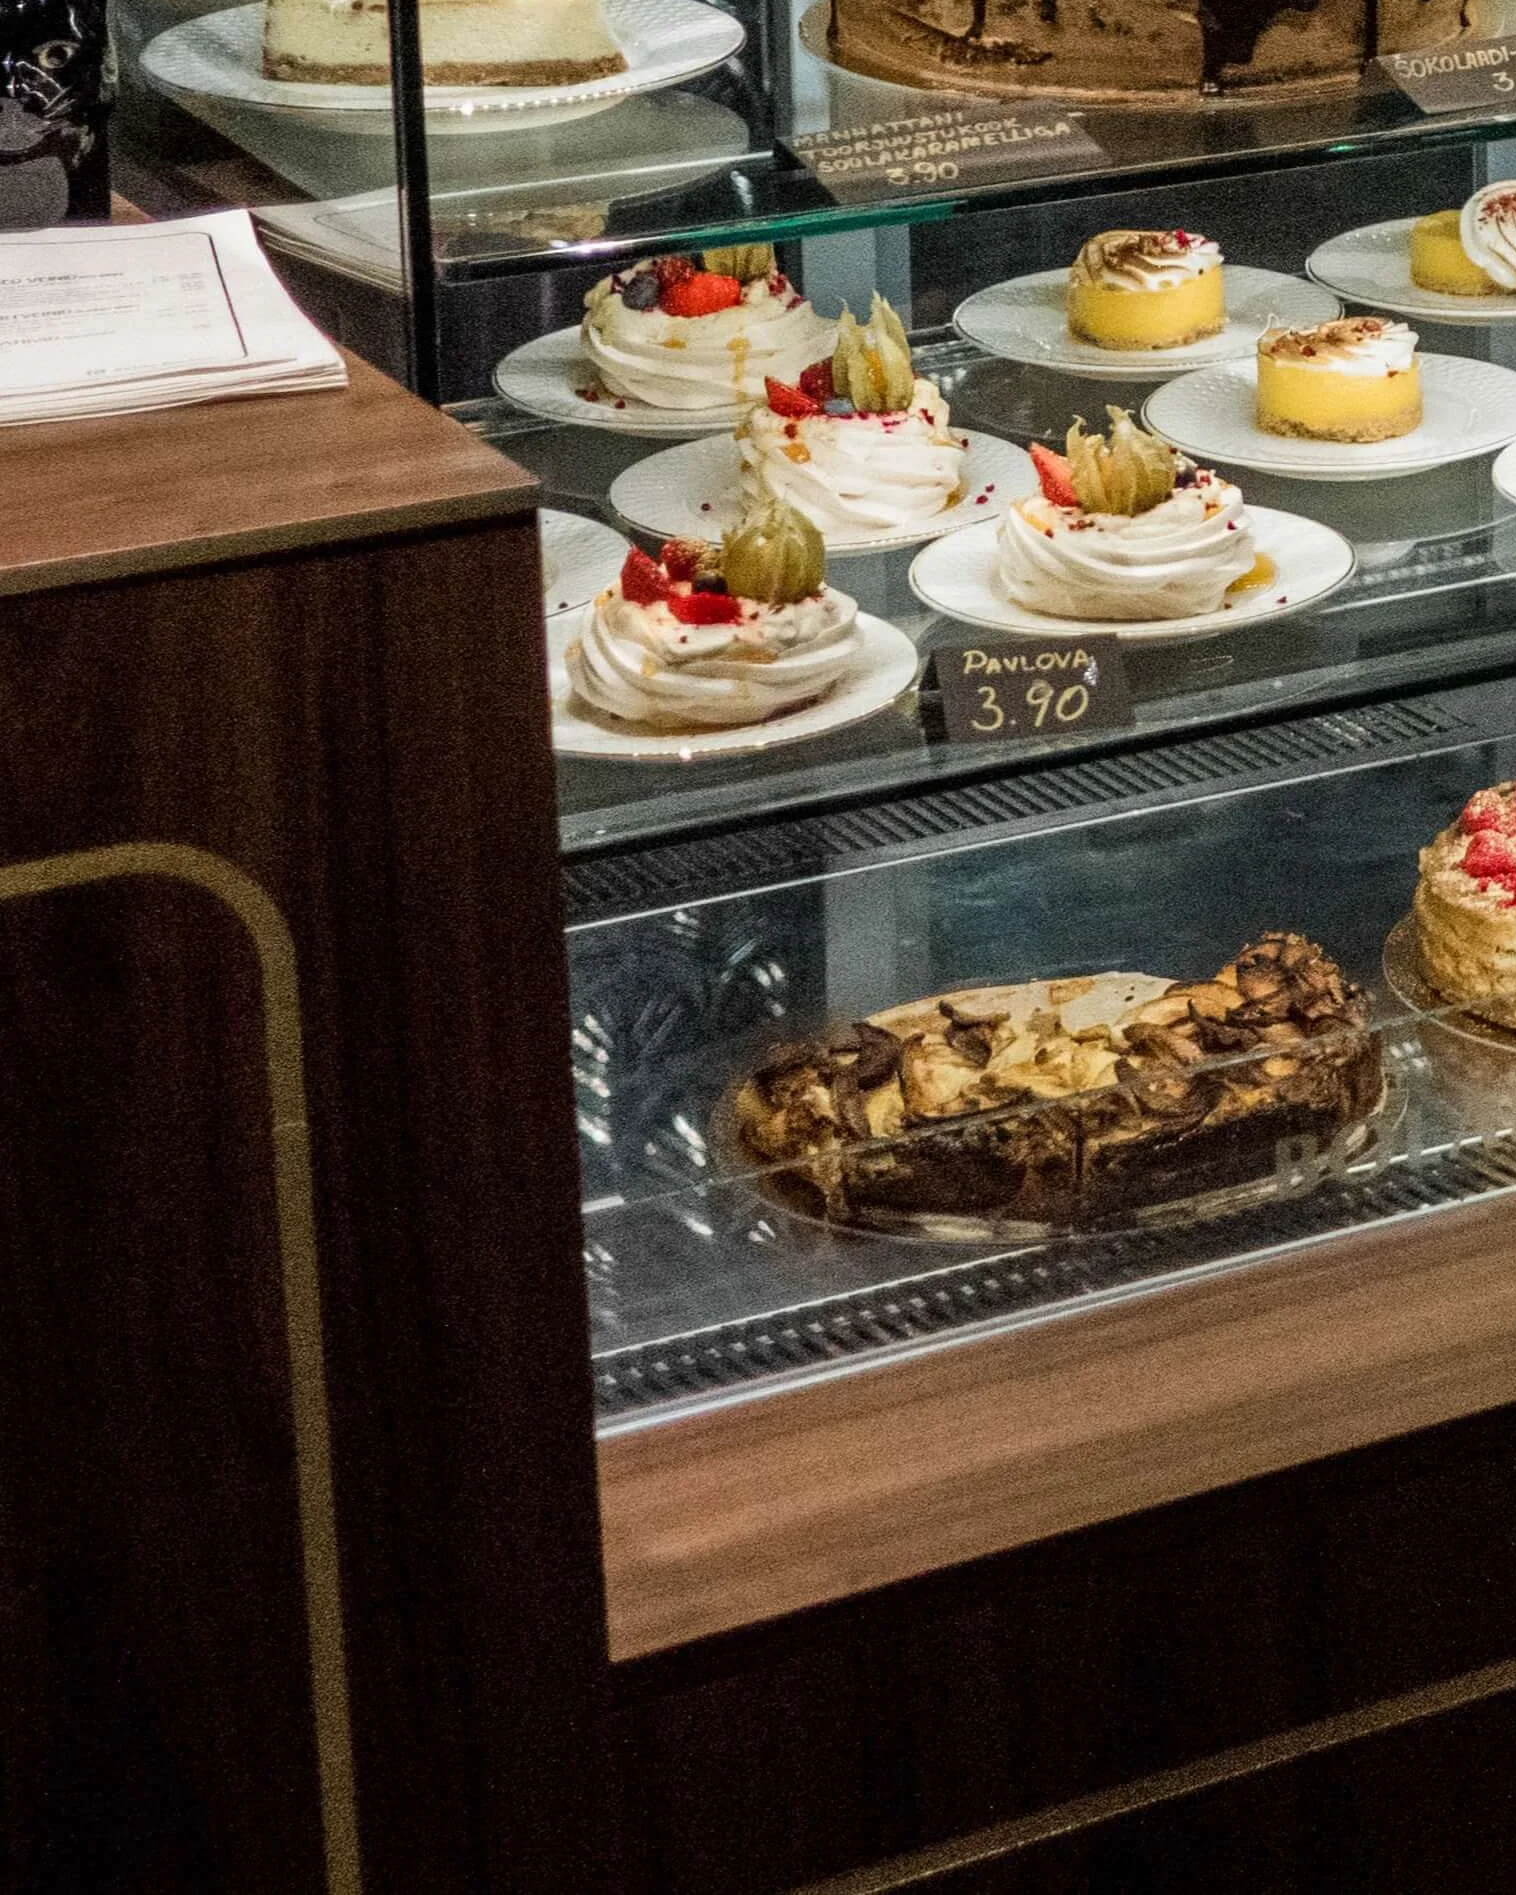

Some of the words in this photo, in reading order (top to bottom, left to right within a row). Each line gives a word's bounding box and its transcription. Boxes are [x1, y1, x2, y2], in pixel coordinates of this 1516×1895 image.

[791, 110, 965, 148] MANHATTANI
[797, 117, 1023, 160] TOORJUUSTUKOOK
[884, 161, 961, 186] 3.90
[962, 648, 1089, 675] PAVLOVA
[971, 679, 1090, 731] 3.90
